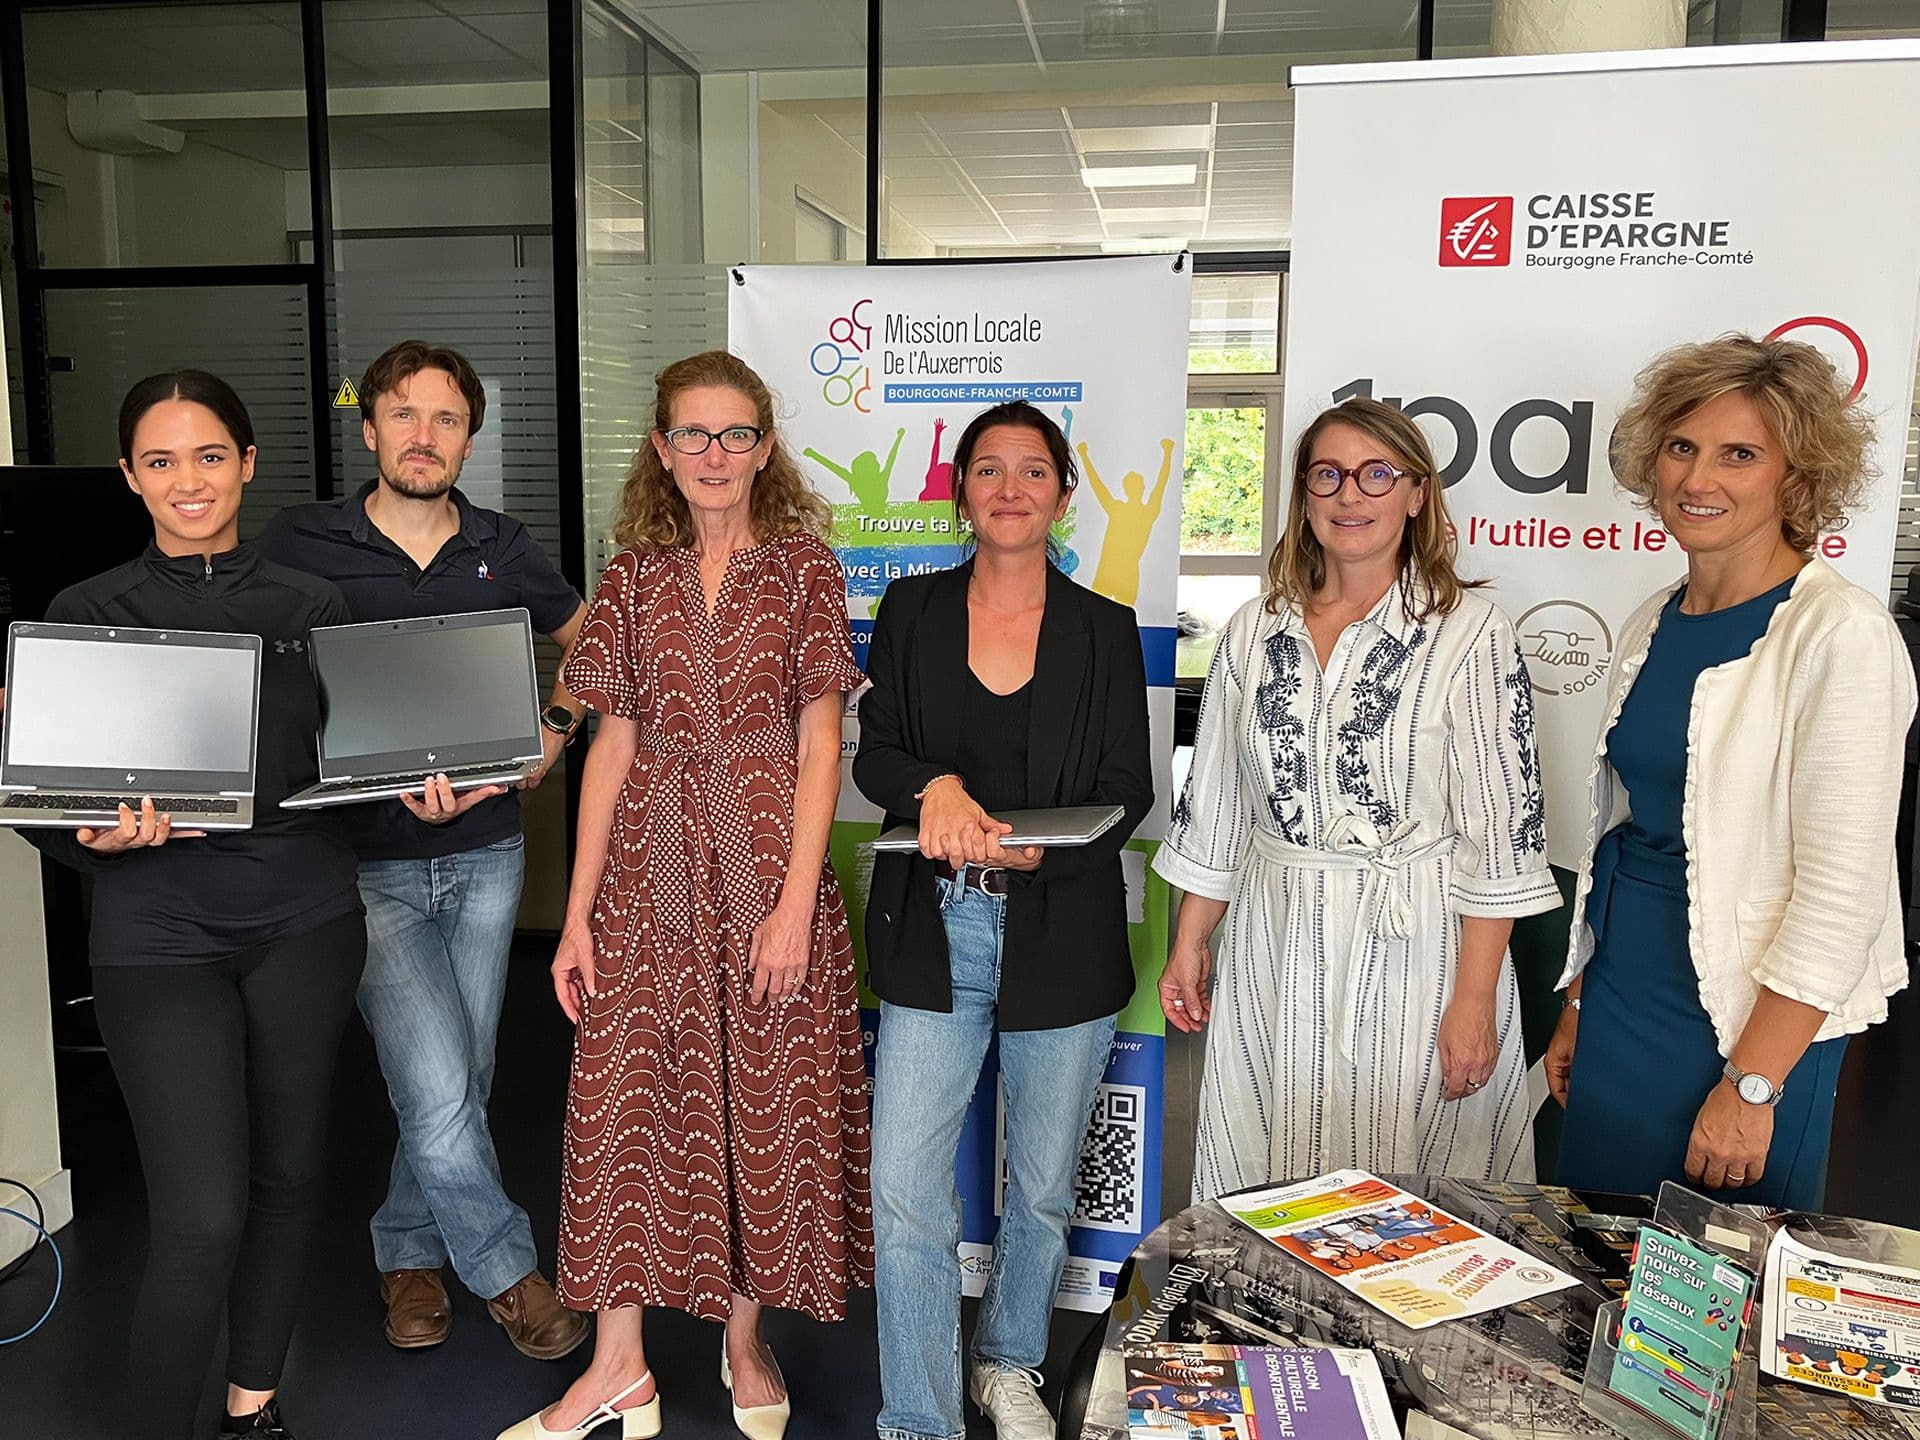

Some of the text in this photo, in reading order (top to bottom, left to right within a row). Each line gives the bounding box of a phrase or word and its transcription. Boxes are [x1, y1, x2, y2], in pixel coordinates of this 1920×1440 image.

[1527, 192, 1655, 220] CAISSE
[1527, 221, 1730, 250] D'EPARGNE
[1525, 250, 1754, 270] Bourgogne Franche-Comté
[884, 312, 1042, 344] Mission Locale
[884, 350, 905, 375] De
[888, 387, 1077, 399] BOURGOGNE-FRANCHE-COMTE
[857, 515, 926, 532] Trouve
[930, 516, 950, 532] ta
[1469, 516, 1571, 549] l'utile
[1583, 523, 1622, 551] et
[1633, 522, 1667, 552] le
[885, 561, 901, 579] la
[1563, 656, 1612, 696] SOCIAL
[1437, 1253, 1489, 1288] JEUNESSE
[1645, 1236, 1705, 1271] Suivez-
[1452, 1256, 1517, 1300] RENCONTRES
[1640, 1264, 1663, 1287] les
[1643, 1253, 1681, 1279] nous
[1683, 1271, 1707, 1291] sur
[1151, 1277, 1193, 1312] digital
[1637, 1281, 1696, 1319] réseaux
[1282, 1354, 1308, 1414] CULTURELLE
[1300, 1354, 1322, 1391] SAISON
[1793, 1366, 1869, 1390] RESSOURCES
[1264, 1353, 1296, 1438] DÉPARTEMENTALE
